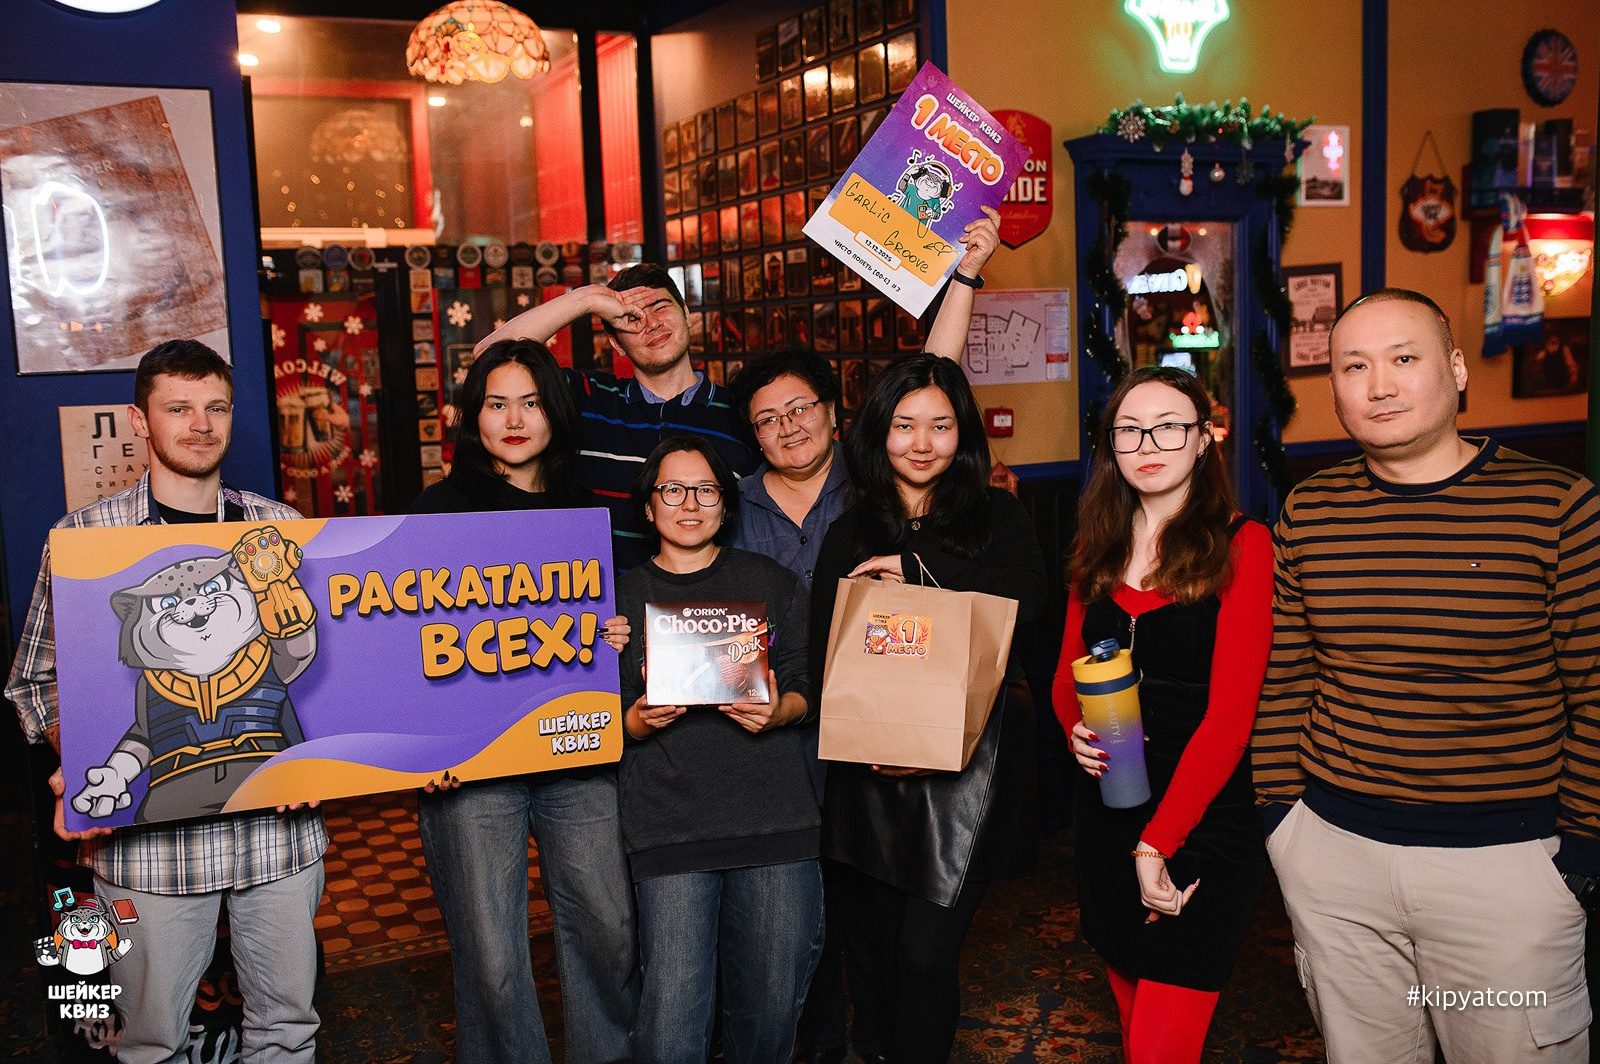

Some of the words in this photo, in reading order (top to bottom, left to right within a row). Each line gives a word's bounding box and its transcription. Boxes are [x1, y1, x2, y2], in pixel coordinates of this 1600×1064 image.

[911, 94, 940, 130] 1
[945, 92, 980, 123] ШЕЙКЕР
[979, 120, 1002, 144] КВИЗ
[924, 112, 1005, 186] МЕСТО
[1002, 176, 1047, 202] IDE
[834, 238, 852, 255] ЧИСТО
[852, 253, 873, 271] ПОПЕТЬ
[864, 239, 893, 263] 13.12.2025
[328, 559, 601, 619] РАСКАТАЛИ
[694, 608, 726, 617] ORION
[900, 619, 917, 645] 1
[420, 612, 597, 681] ВСЕХ!
[728, 637, 766, 662] Dark
[886, 642, 928, 657] МЕСТО
[538, 710, 612, 736] ШЕЙКЕР
[551, 733, 601, 755] КВИЗ
